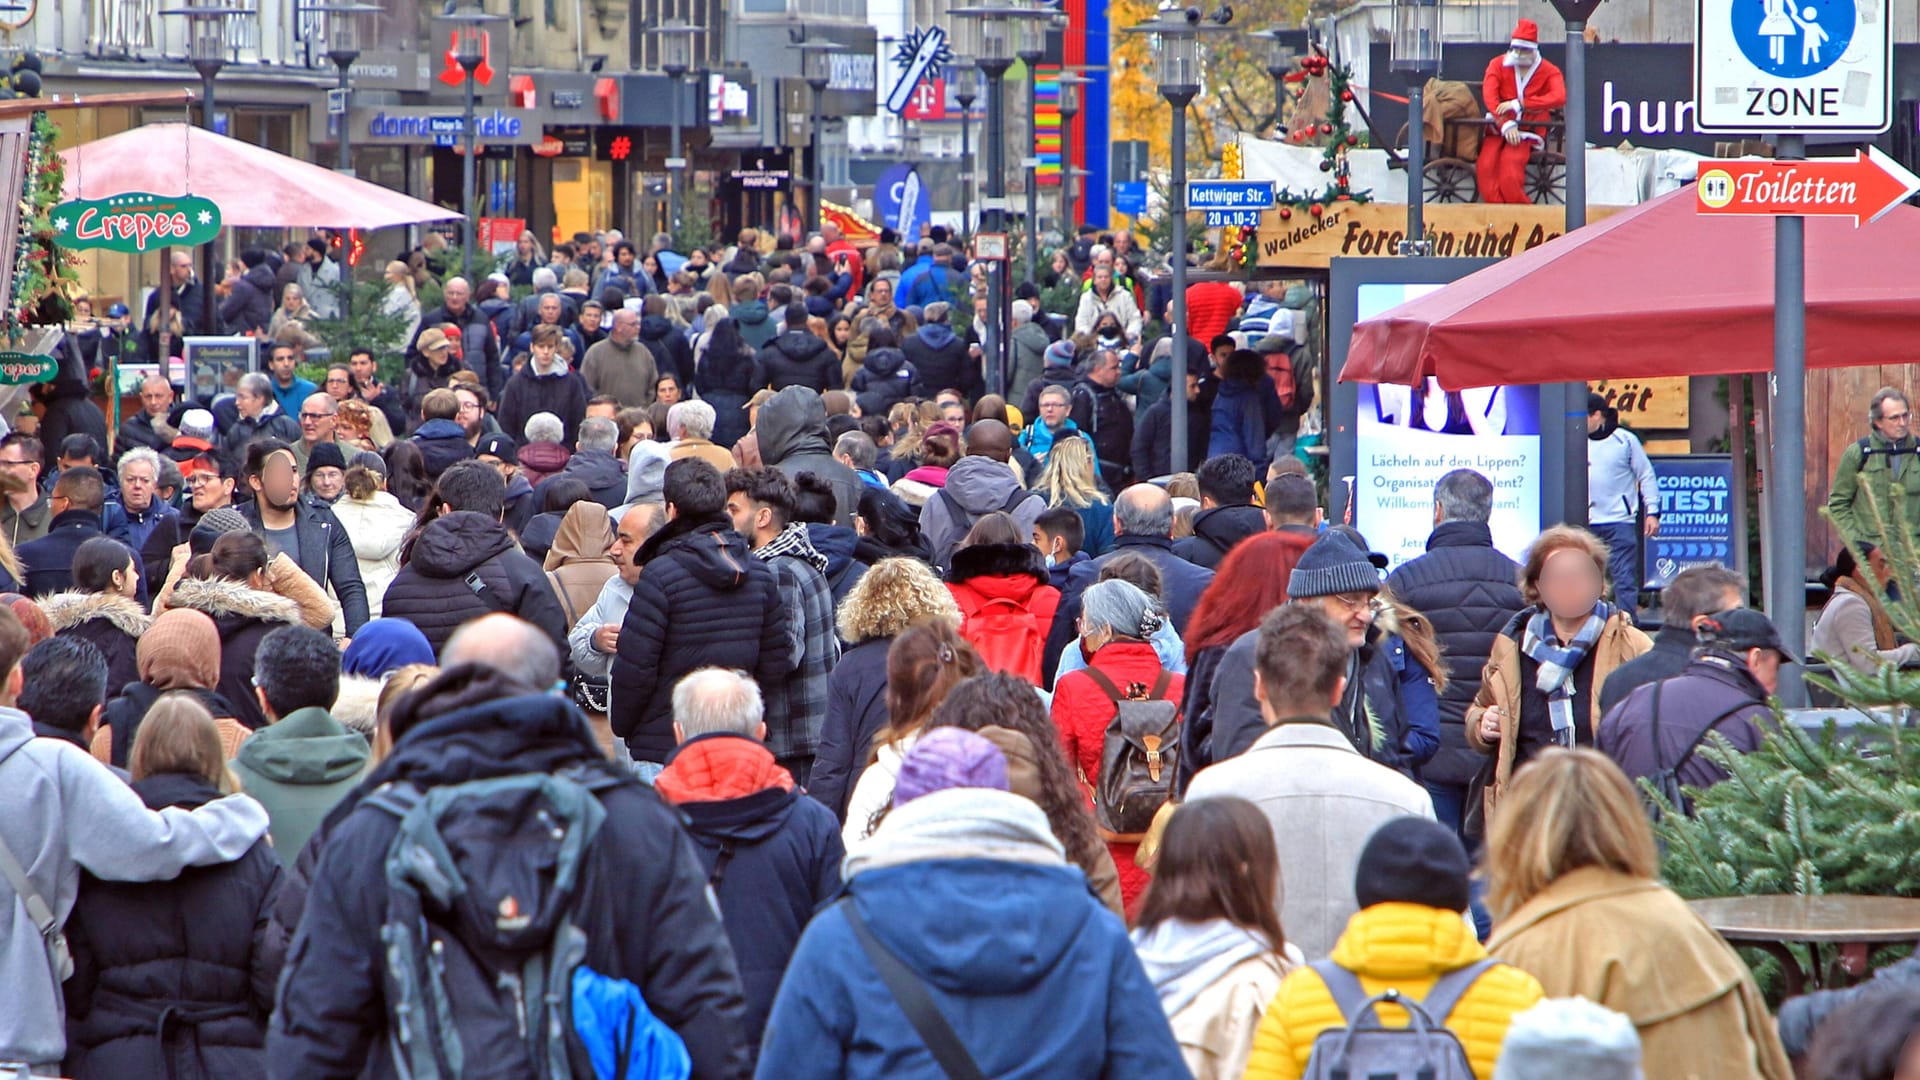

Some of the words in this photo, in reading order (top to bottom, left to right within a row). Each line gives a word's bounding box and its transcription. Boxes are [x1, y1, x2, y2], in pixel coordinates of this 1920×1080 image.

[1746, 87, 1840, 117] ZONE
[1191, 189, 1244, 204] Kettwiger
[1247, 188, 1266, 203] Str.
[1737, 168, 1857, 204] Toiletten
[76, 207, 191, 249] Crepes
[1208, 211, 1221, 226] 20
[1264, 211, 1342, 257] Waldecker
[1464, 222, 1520, 257] und
[1372, 454, 1420, 468] Lächeln
[1424, 454, 1446, 468] auf
[1449, 454, 1472, 468] den
[1477, 454, 1527, 471] Lippen?
[1657, 476, 1727, 489] CORONA
[1659, 490, 1728, 511] TEST
[1659, 512, 1729, 525] ZENTRUM
